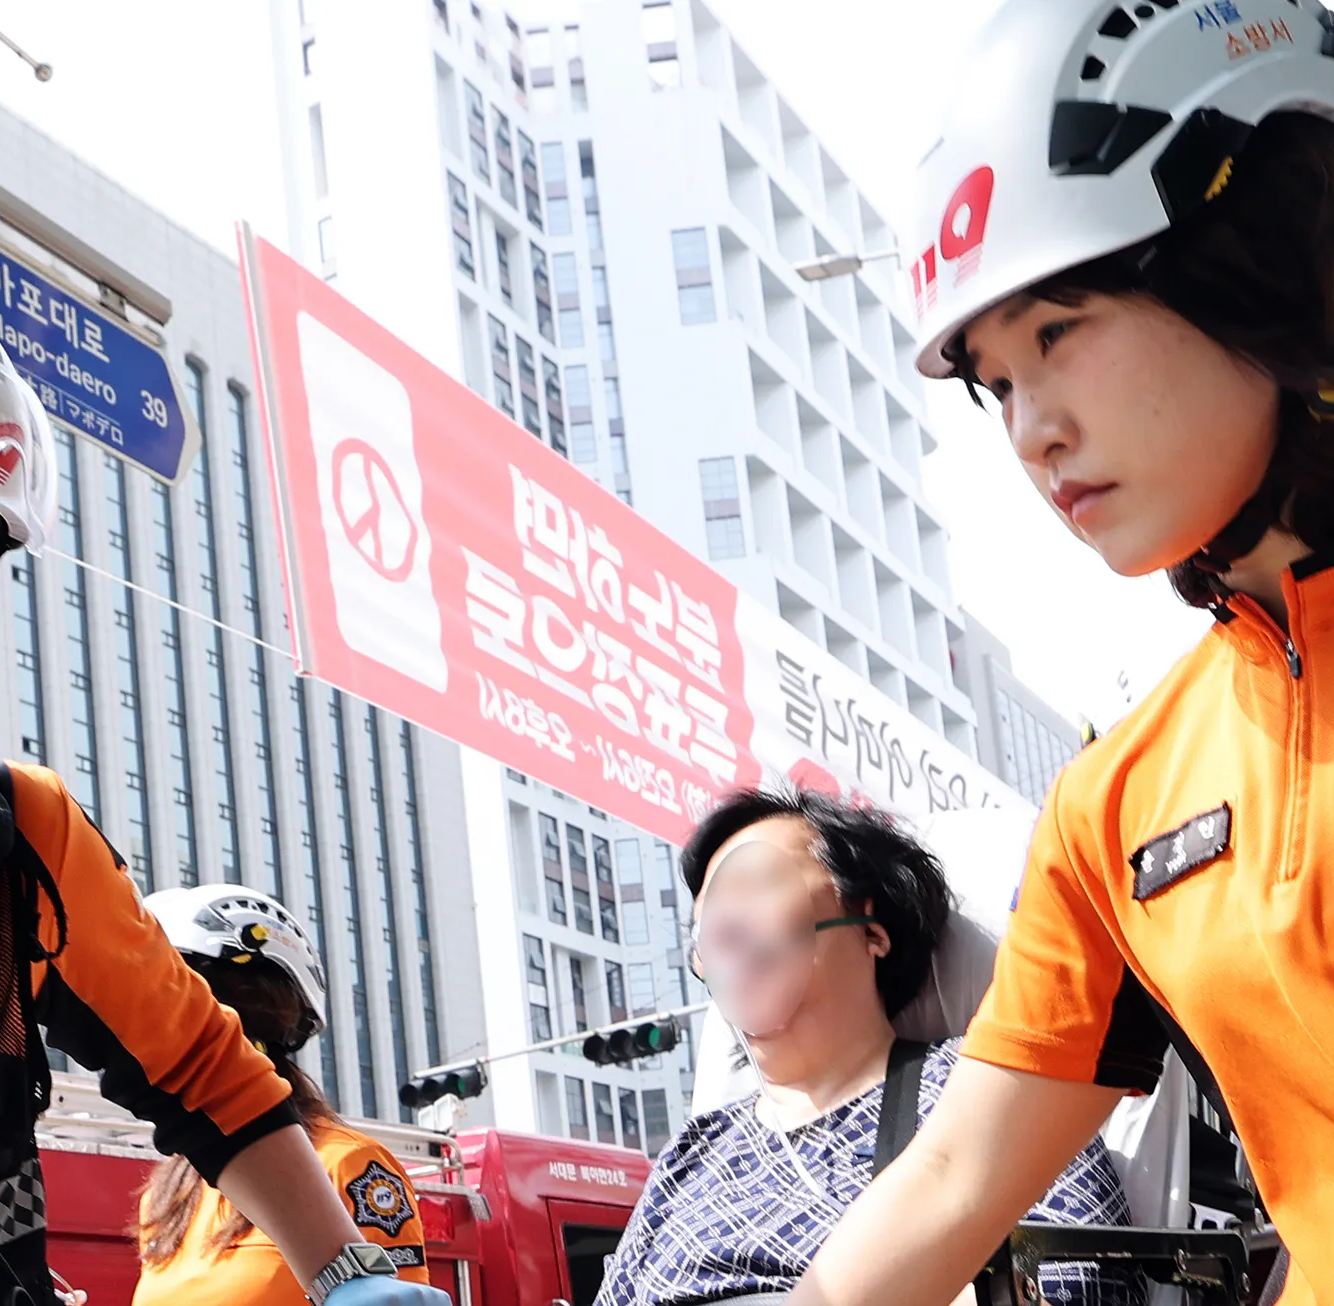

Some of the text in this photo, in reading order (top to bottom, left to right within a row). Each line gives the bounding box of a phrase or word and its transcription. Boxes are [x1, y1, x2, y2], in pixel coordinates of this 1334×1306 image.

[1193, 0, 1243, 32] 서울
[1226, 16, 1294, 62] 소방서
[910, 165, 995, 327] 119
[66, 401, 124, 447] マポデロ
[140, 389, 167, 428] 39
[548, 1160, 578, 1182] 서대문
